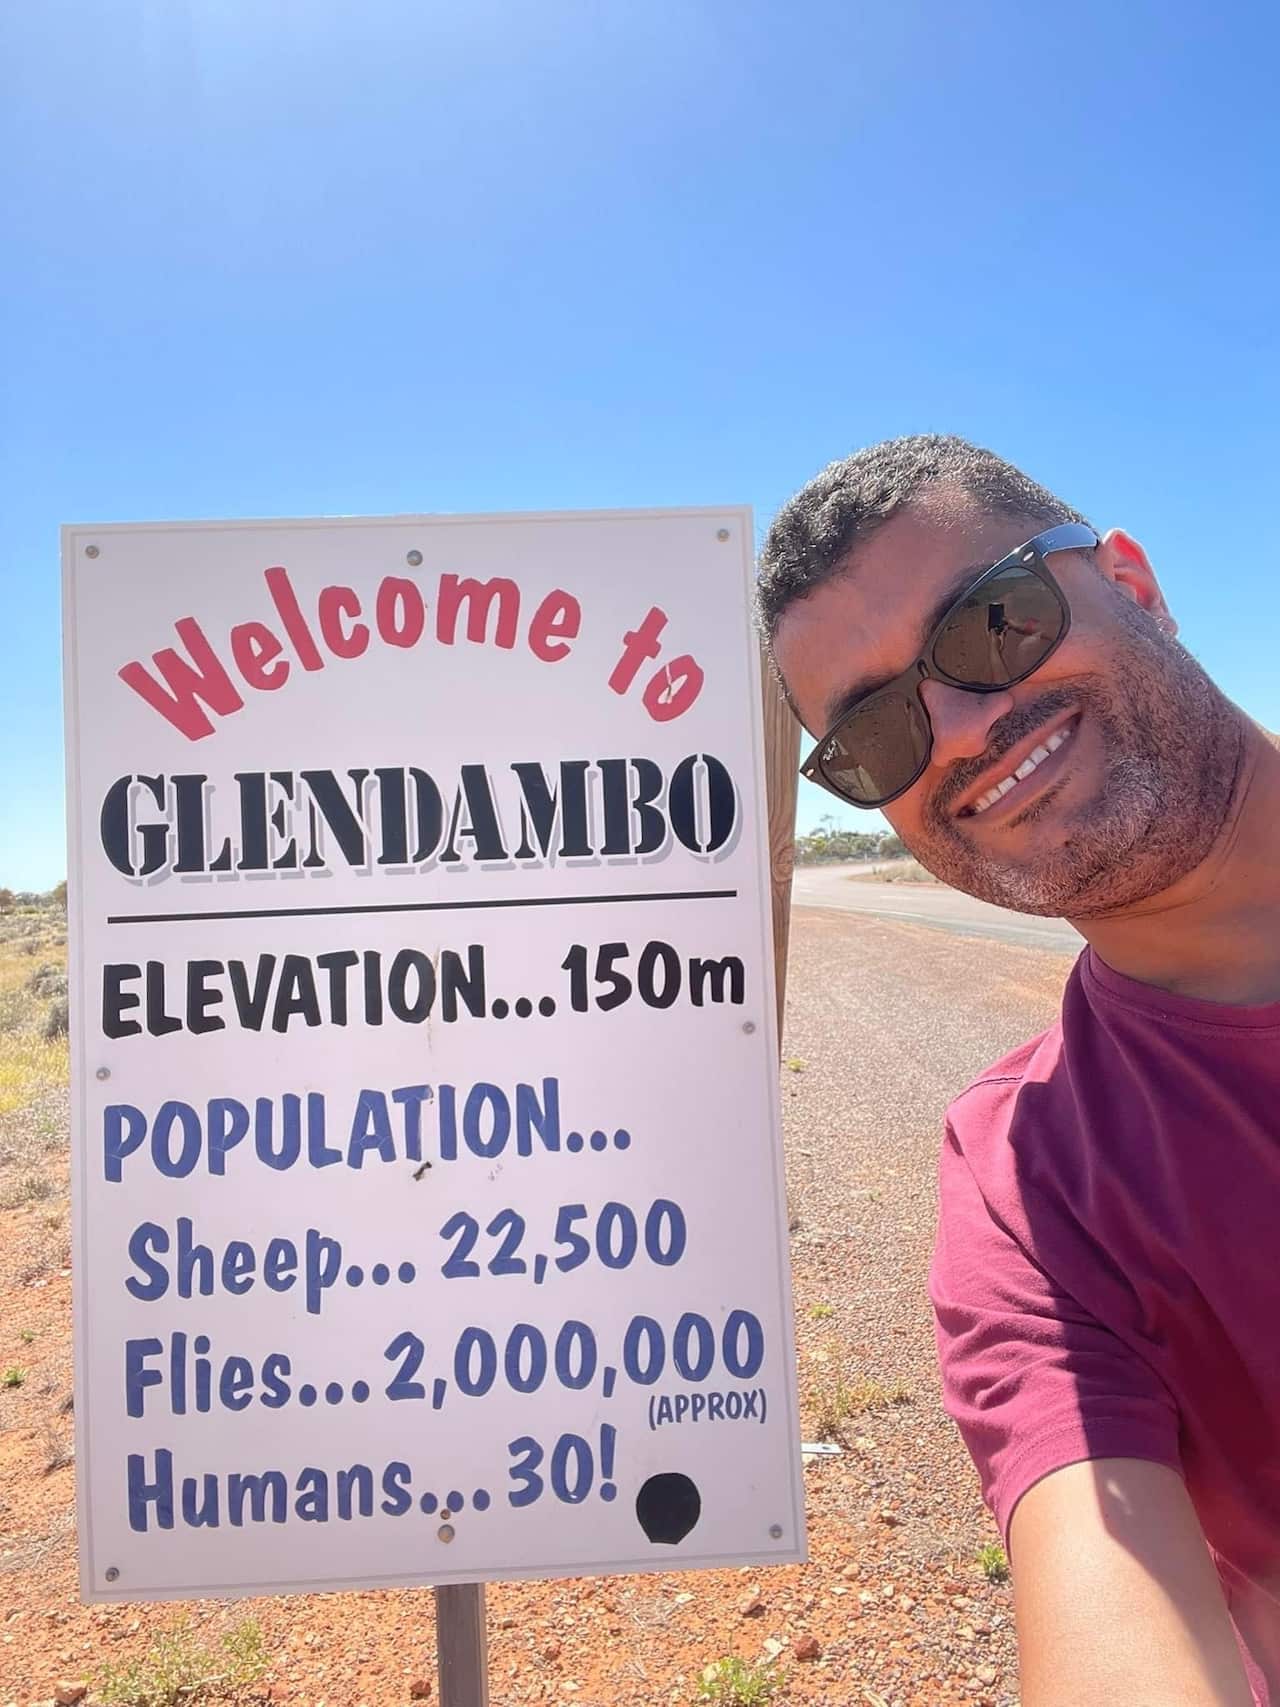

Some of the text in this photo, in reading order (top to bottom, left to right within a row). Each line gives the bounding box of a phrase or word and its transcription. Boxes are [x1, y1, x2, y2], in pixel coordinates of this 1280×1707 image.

[117, 566, 704, 742] Welcome to
[101, 753, 741, 884] GLENDAMBO
[439, 1198, 687, 1285] 22,500
[648, 1388, 767, 1431] (APPROX)
